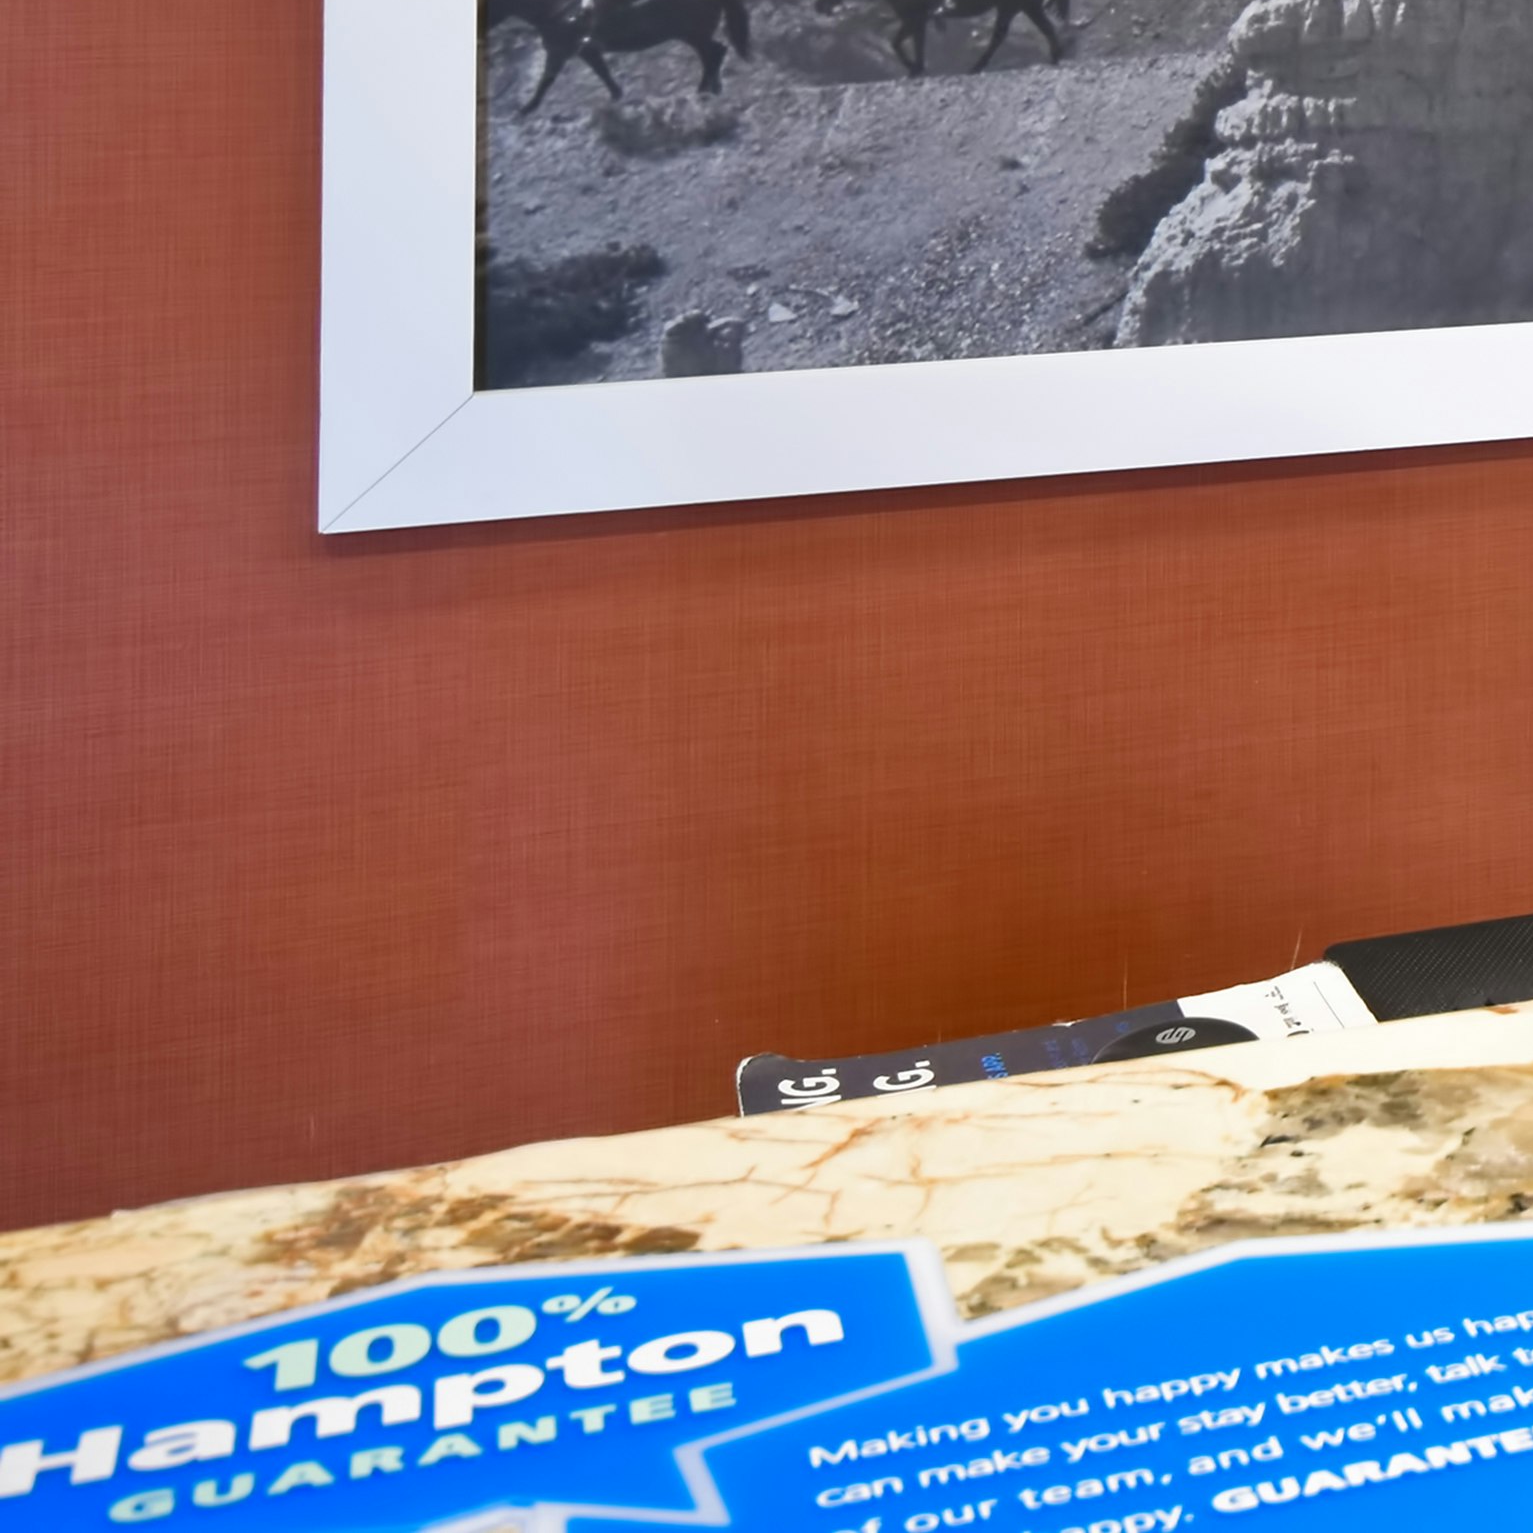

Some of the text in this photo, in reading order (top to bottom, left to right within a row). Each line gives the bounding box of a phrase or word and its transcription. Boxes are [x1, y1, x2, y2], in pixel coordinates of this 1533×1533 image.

[0, 1309, 845, 1498] Hampton
[245, 1287, 637, 1390] 100%
[809, 1418, 991, 1468] Making
[1003, 1398, 1090, 1433] you
[1102, 1368, 1241, 1409] happy
[1255, 1339, 1395, 1379] makes
[1405, 1327, 1455, 1349] us
[110, 1383, 736, 1521] GUARANTEE
[816, 1477, 904, 1507] can
[918, 1447, 1050, 1488] make
[1061, 1422, 1165, 1462] your
[1178, 1402, 1266, 1434] stay
[1276, 1373, 1418, 1415] better,
[1425, 1353, 1506, 1384] talk
[905, 1499, 997, 1533] our
[1019, 1468, 1172, 1509] team,
[1188, 1435, 1284, 1475] and
[1300, 1407, 1423, 1450] we'll
